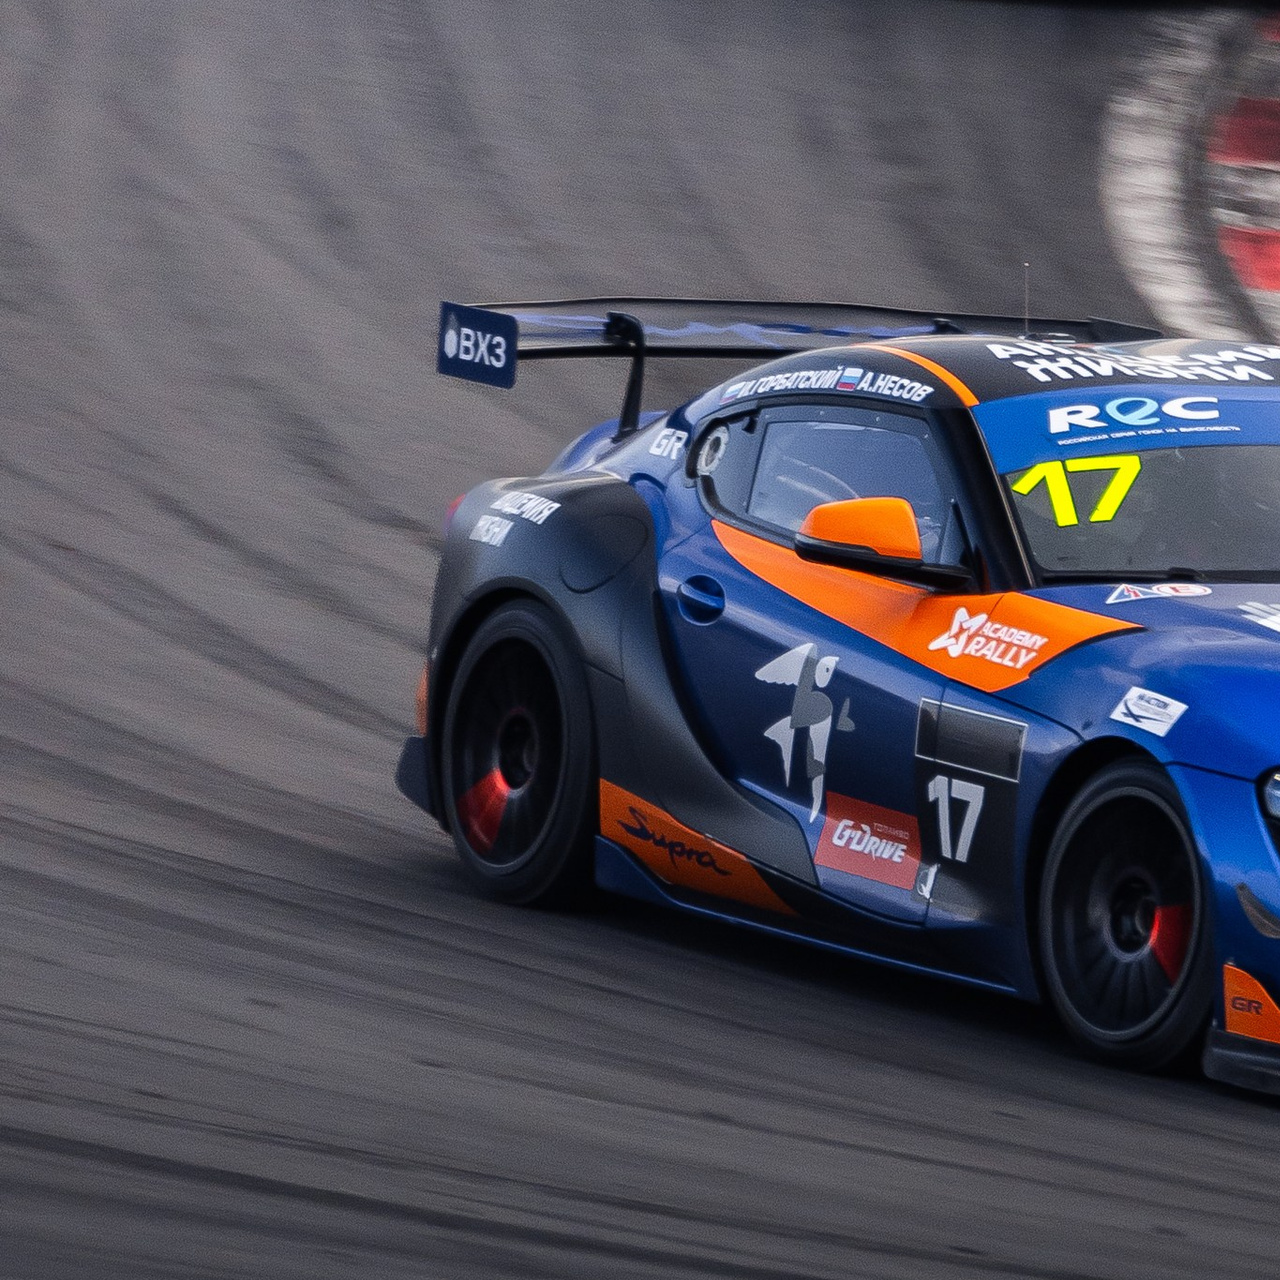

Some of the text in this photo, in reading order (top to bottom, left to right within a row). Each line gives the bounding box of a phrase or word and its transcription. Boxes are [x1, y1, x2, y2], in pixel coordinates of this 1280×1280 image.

[459, 327, 506, 368] BX3
[857, 372, 935, 403] А.НЕСОВ
[649, 428, 688, 460] GR
[1011, 454, 1142, 528] 17
[980, 622, 1049, 648] ACADEMY
[964, 638, 1038, 669] RALLY
[928, 774, 986, 864] 17
[617, 805, 733, 876] Supra
[1231, 996, 1263, 1016] GR
